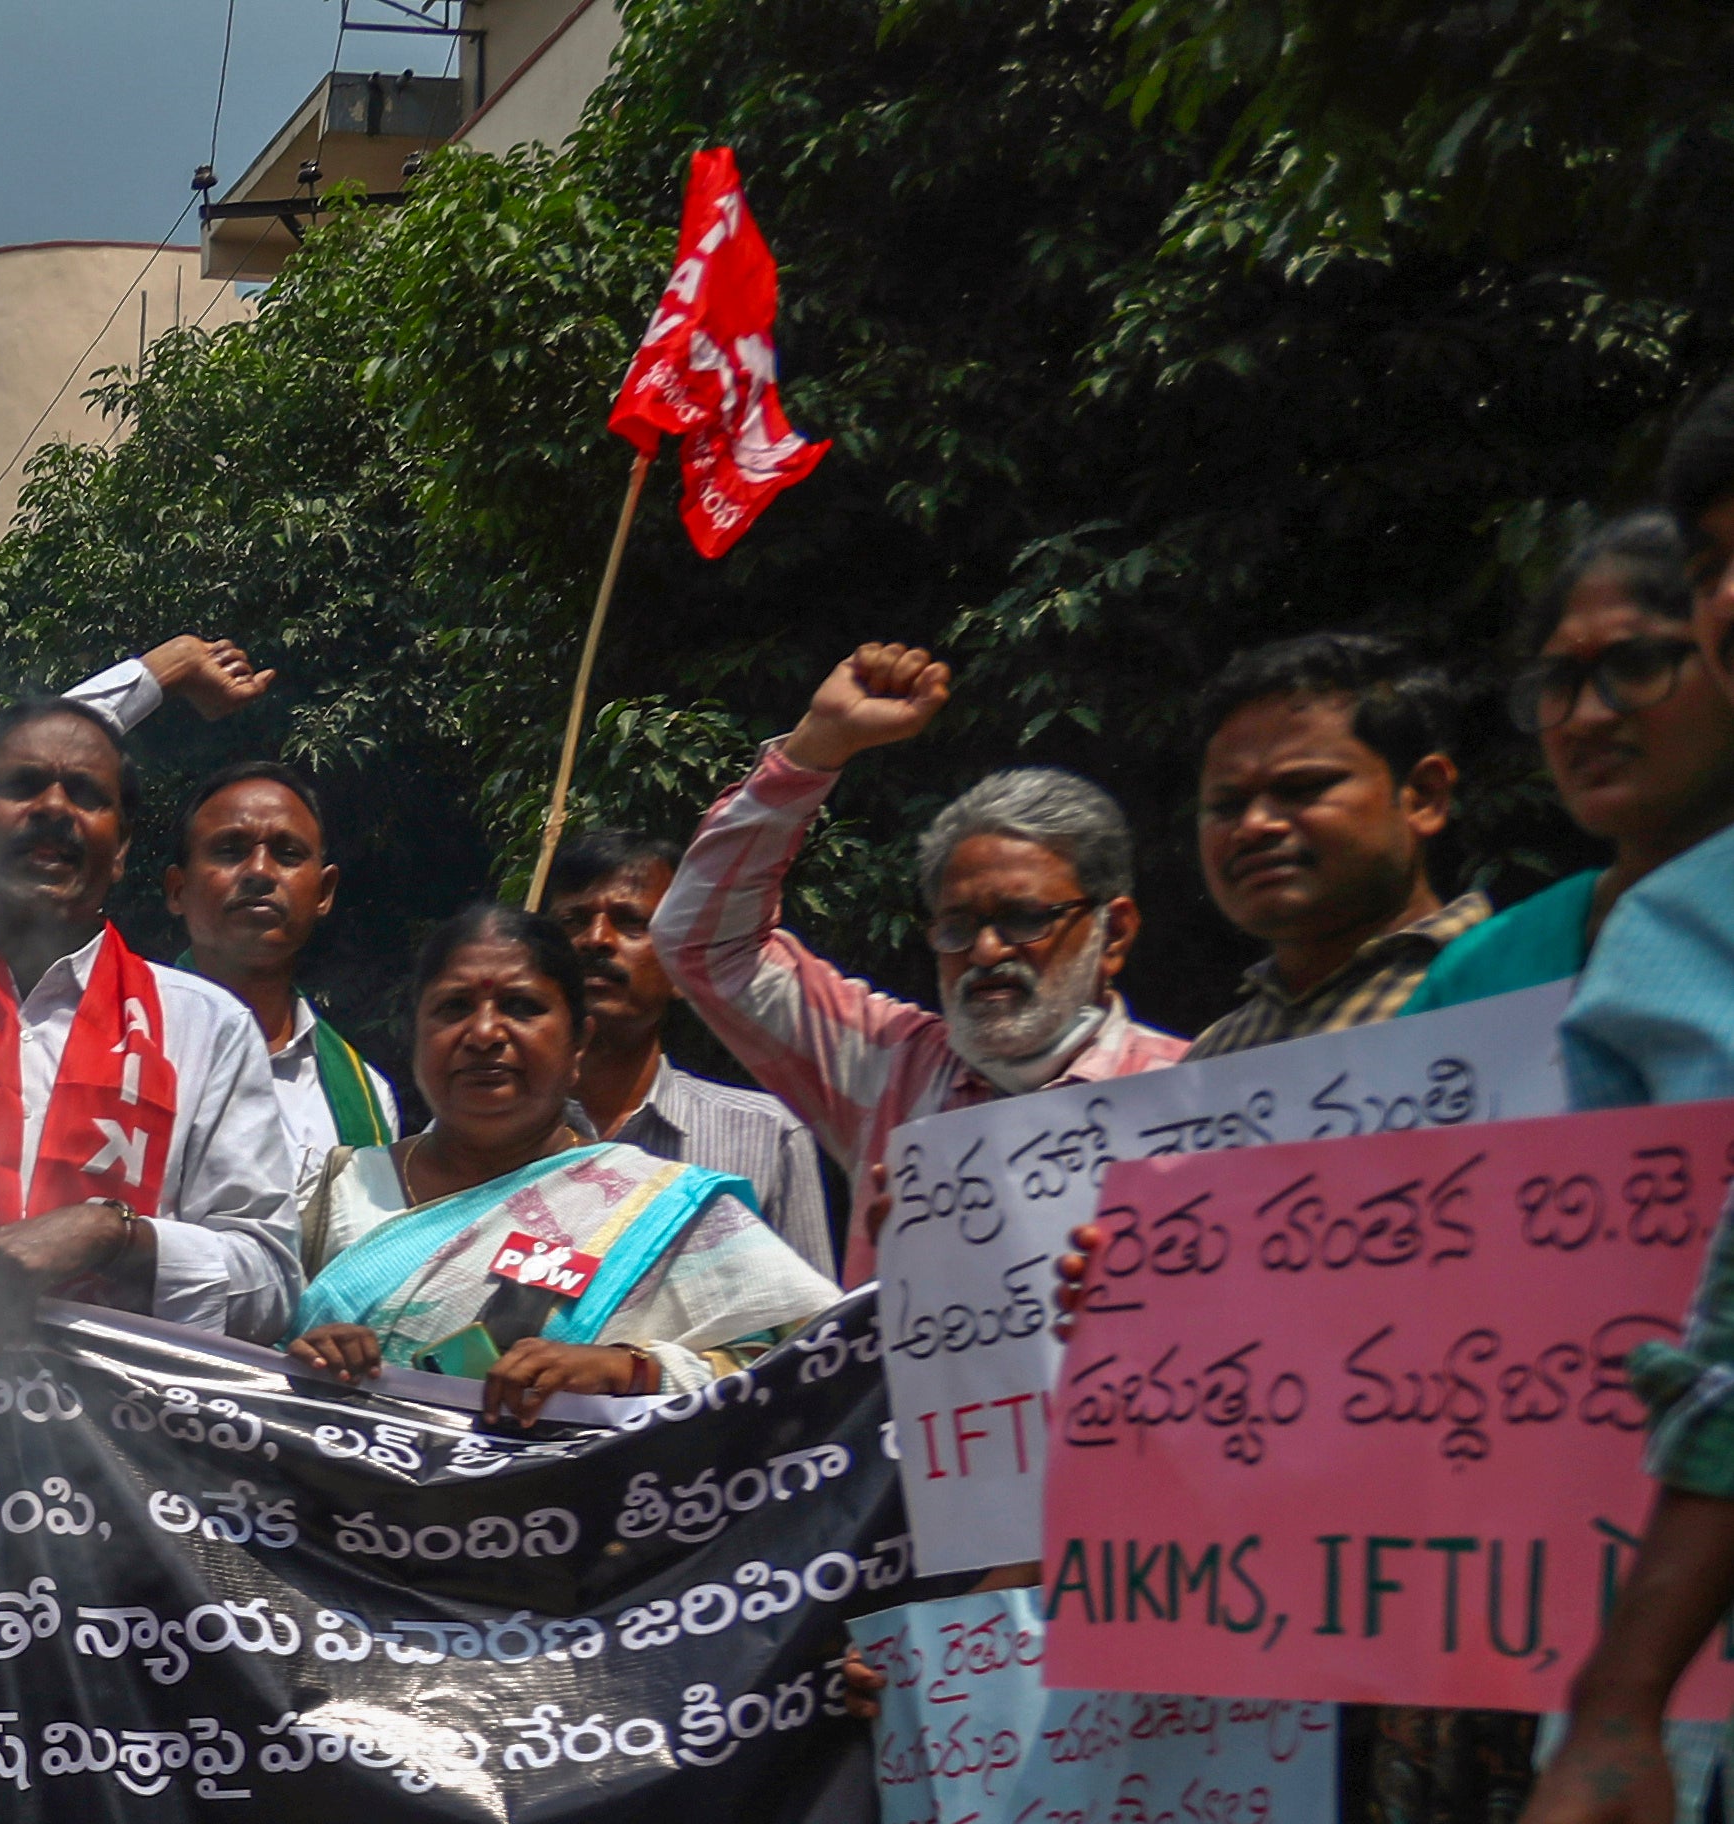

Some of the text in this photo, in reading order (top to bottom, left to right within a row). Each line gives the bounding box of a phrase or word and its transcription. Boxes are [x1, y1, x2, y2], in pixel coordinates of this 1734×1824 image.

[1064, 1339, 1307, 1466] ప్రభుత్వం
[147, 1480, 298, 1549] అనేక
[332, 1505, 581, 1562] మందిని
[615, 1442, 850, 1544] తీవ్రంగా
[75, 1598, 302, 1685] న్యాయ
[1044, 1535, 1288, 1650] AIKMS,
[1314, 1535, 1561, 1673] IFTU,
[41, 1717, 252, 1800] మిశ్రాపై
[503, 1703, 666, 1772] నేరం
[676, 1673, 814, 1766] క్రింద
